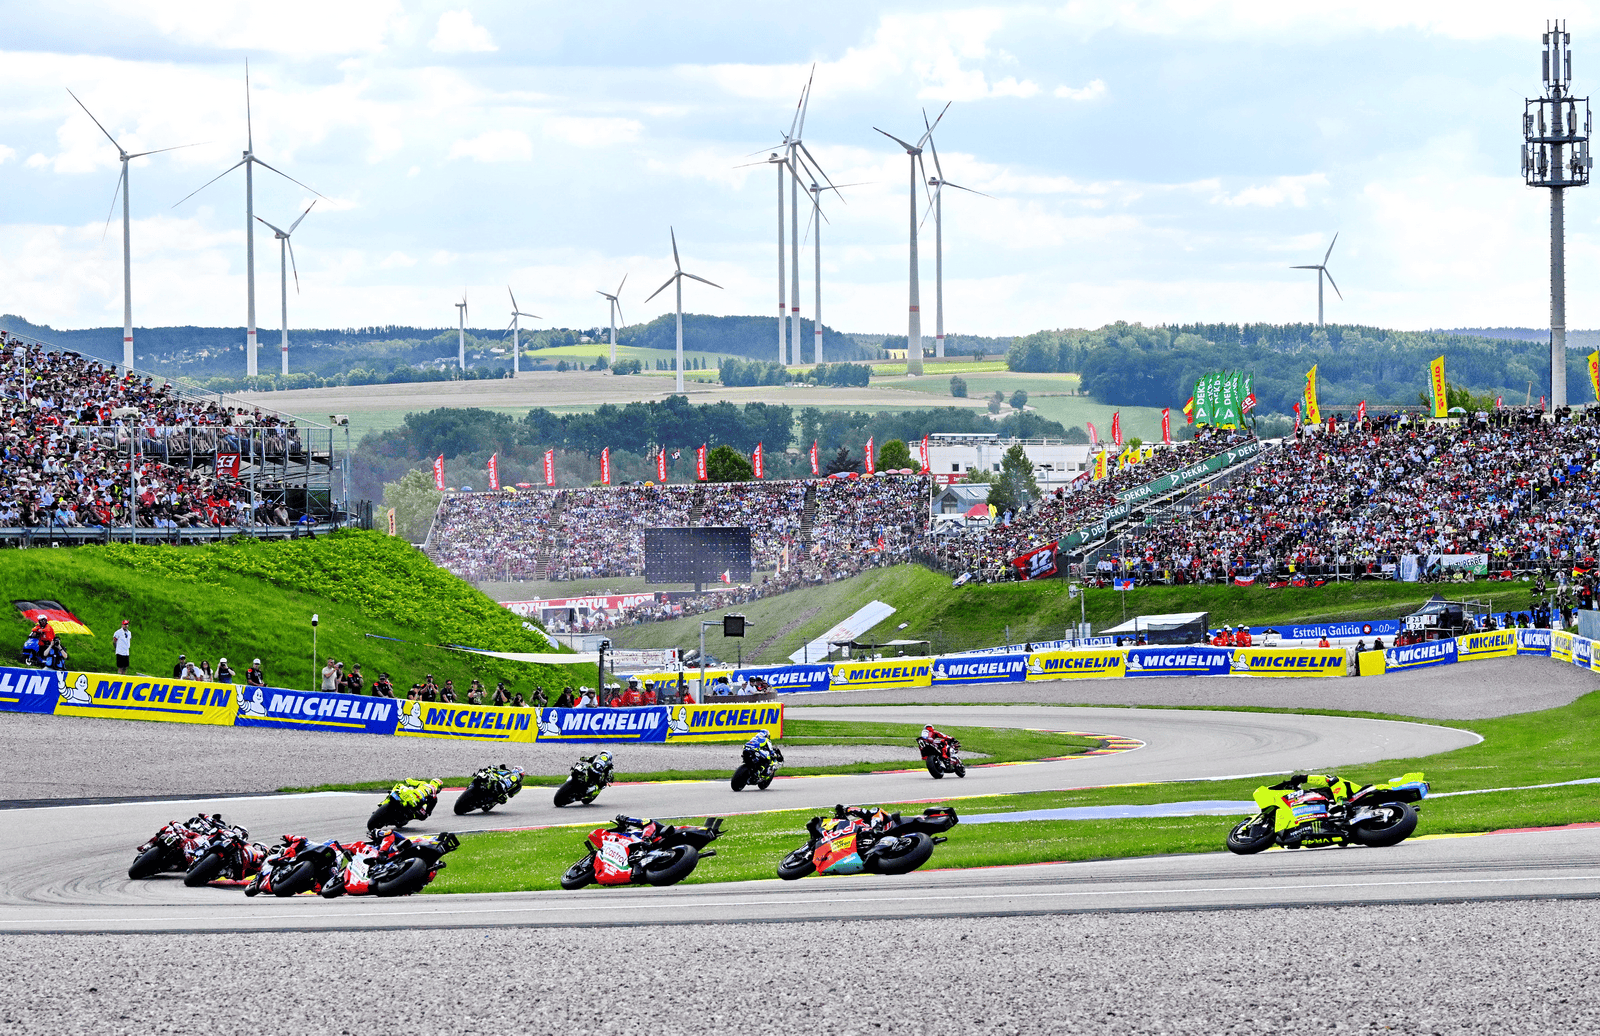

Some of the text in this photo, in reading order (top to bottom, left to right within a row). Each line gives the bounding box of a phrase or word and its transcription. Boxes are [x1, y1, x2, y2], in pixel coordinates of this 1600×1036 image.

[1180, 463, 1209, 480] DEKRA
[1124, 486, 1153, 501] DEKRA
[1030, 550, 1051, 570] 12
[1293, 627, 1327, 637] Estrella
[1328, 625, 1360, 635] Galicia
[1469, 634, 1515, 649] MICHELIN
[1399, 642, 1455, 662] MICHELIN
[948, 661, 1024, 676] MICHELIN
[1045, 657, 1120, 670] MICHELIN
[1143, 655, 1226, 667] MICHELIN
[1250, 656, 1343, 667] MICHELIN
[849, 666, 929, 681] MICHELIN
[93, 680, 232, 708] MICHELIN
[268, 693, 392, 722] MICHELIN
[425, 707, 532, 731] MICHELIN
[562, 712, 661, 731] MICHELIN
[690, 708, 780, 727] MICHELIN
